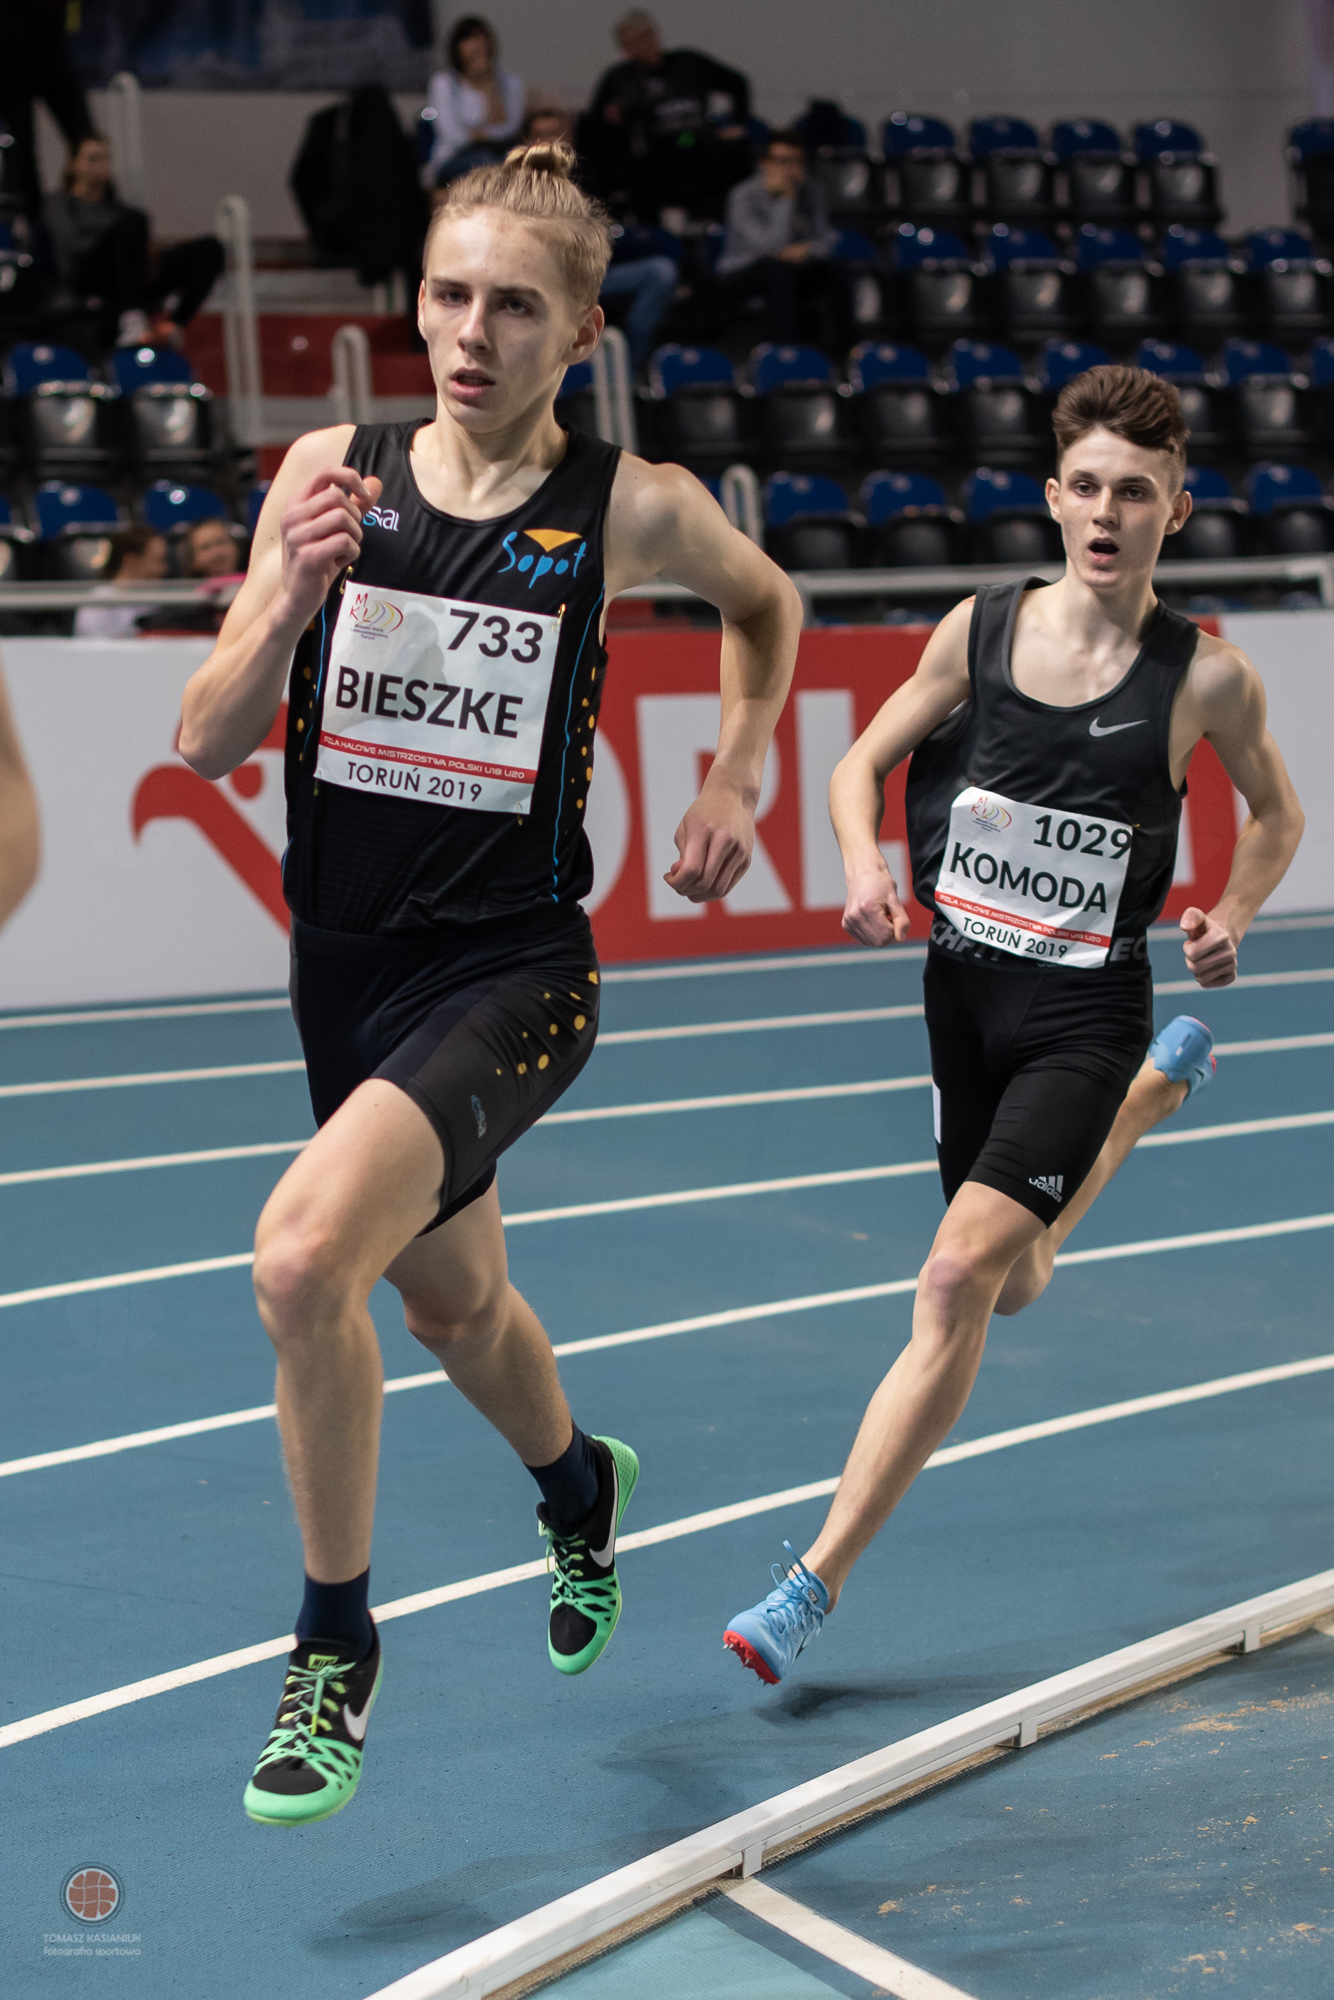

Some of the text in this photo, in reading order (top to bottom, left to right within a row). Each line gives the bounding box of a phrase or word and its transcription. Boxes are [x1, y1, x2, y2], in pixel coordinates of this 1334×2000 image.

[497, 531, 587, 589] Sopot
[447, 608, 544, 664] 733
[335, 665, 524, 739] BIESZKE
[340, 740, 377, 754] HALOWE
[377, 748, 446, 766] MISTRZOSTWA
[448, 760, 482, 772] POLSKI
[484, 766, 502, 775] U18
[504, 769, 525, 779] U20
[347, 760, 482, 802] TORUŃ 2019
[1033, 814, 1132, 860] 1029
[949, 841, 1107, 914] KOMODA
[959, 901, 991, 916] HALOWE
[964, 916, 1068, 959] TORUŃ 2019
